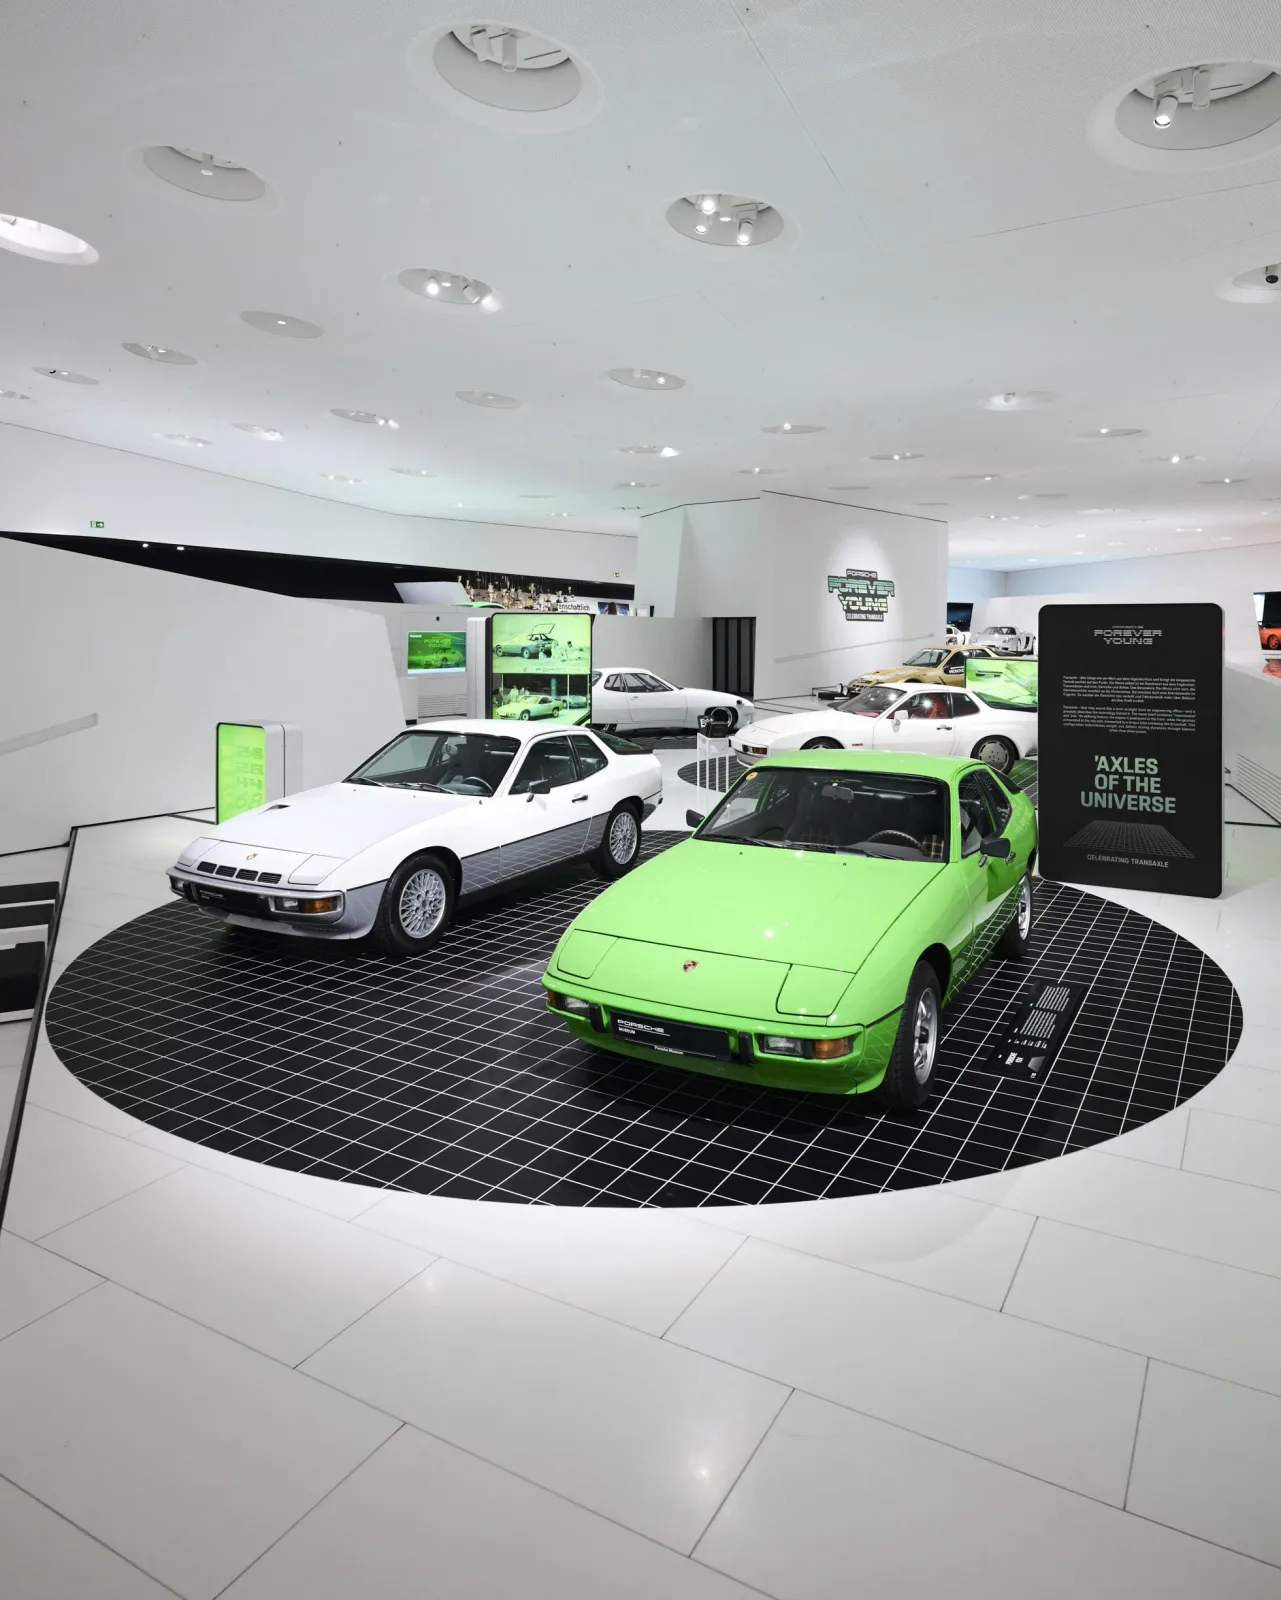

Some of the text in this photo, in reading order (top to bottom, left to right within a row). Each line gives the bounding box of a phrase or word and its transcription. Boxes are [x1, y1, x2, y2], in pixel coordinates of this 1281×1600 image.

[847, 570, 877, 578] PORSCHE
[828, 576, 895, 597] FOREVER
[838, 595, 888, 612] YOUNG
[1094, 629, 1162, 637] FOREVER
[1103, 637, 1153, 645] YOUNG
[1094, 755, 1159, 775] 'AXLES
[1094, 773, 1161, 794] OF THE
[1080, 791, 1176, 814] UNIVERSE
[1086, 854, 1169, 868] CELEBRATING TRANSAXLE
[617, 1019, 665, 1034] PORSCHE
